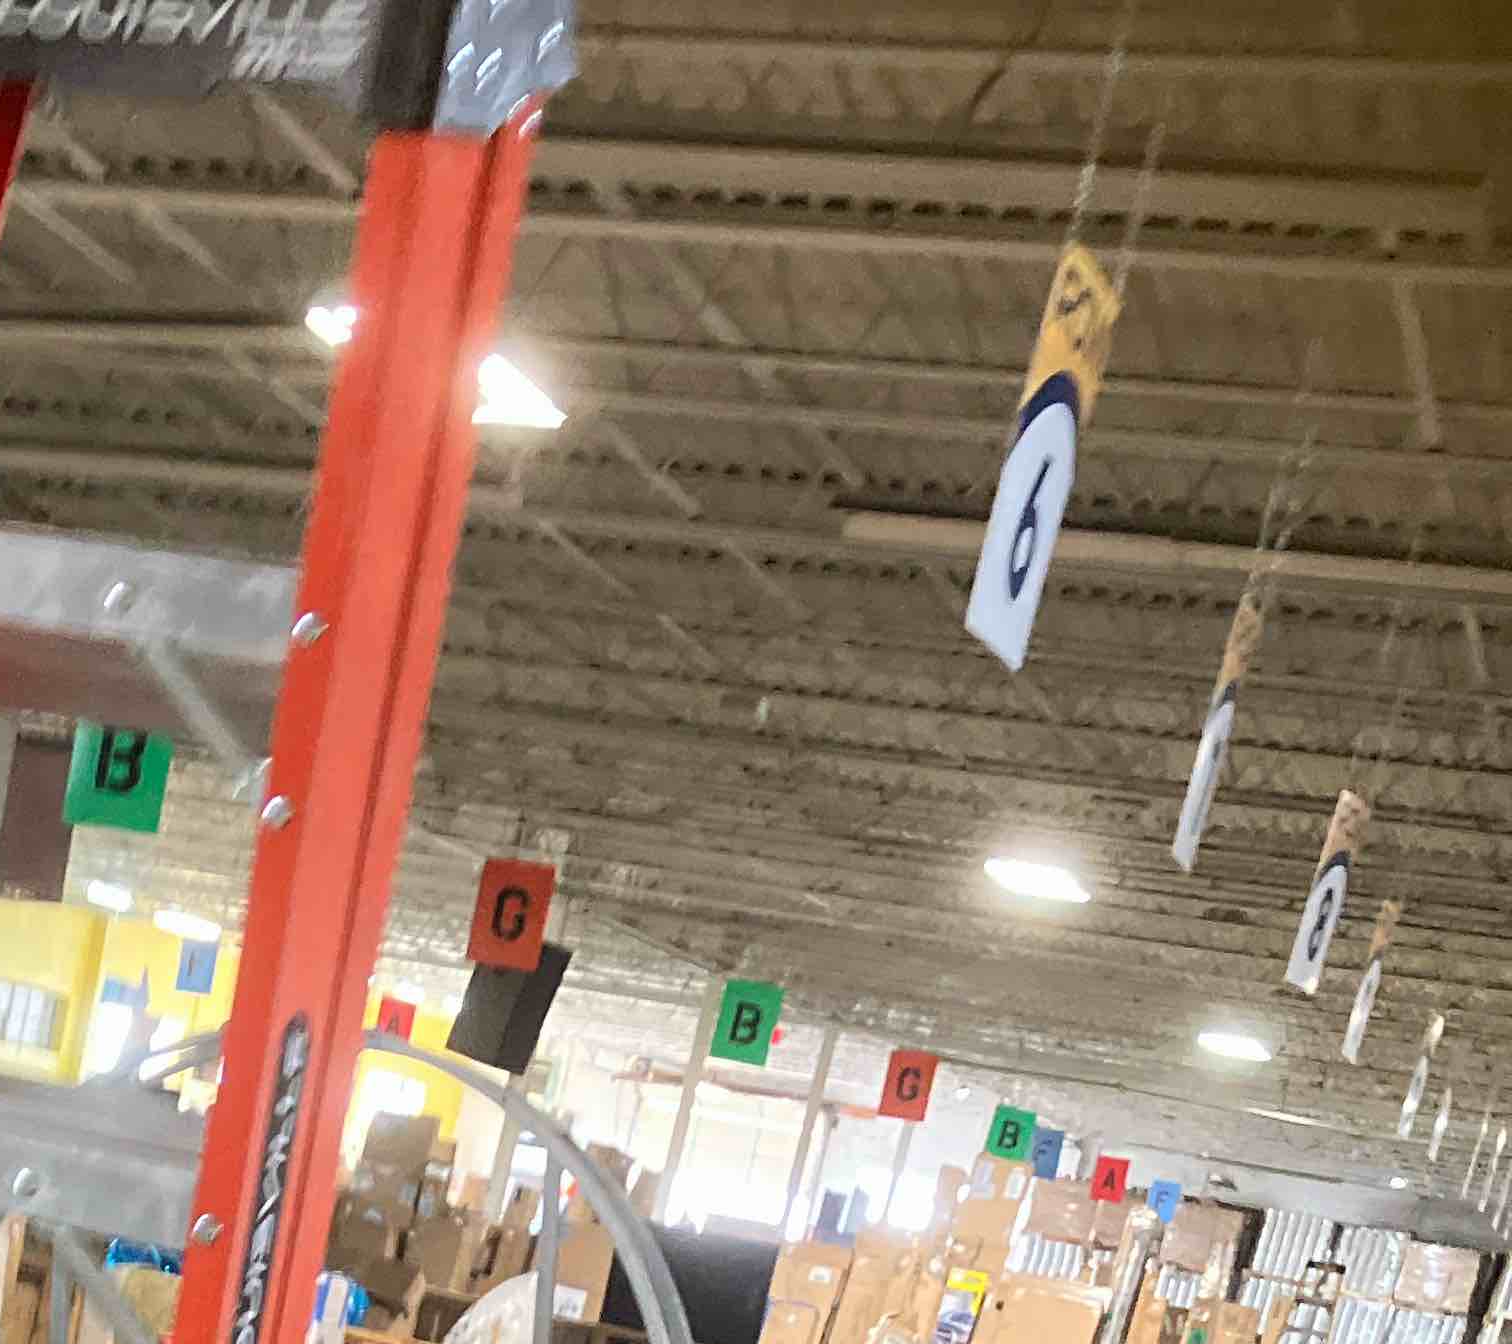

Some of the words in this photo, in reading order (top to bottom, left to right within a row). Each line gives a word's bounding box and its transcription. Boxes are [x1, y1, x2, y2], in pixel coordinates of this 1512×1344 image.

[1009, 454, 1054, 601] 6
[94, 724, 148, 793] B
[491, 885, 531, 942] G
[1307, 887, 1334, 963] 8
[729, 1001, 763, 1045] B
[895, 1067, 922, 1103] G
[997, 1119, 1021, 1150] B
[1102, 1167, 1117, 1191] A
